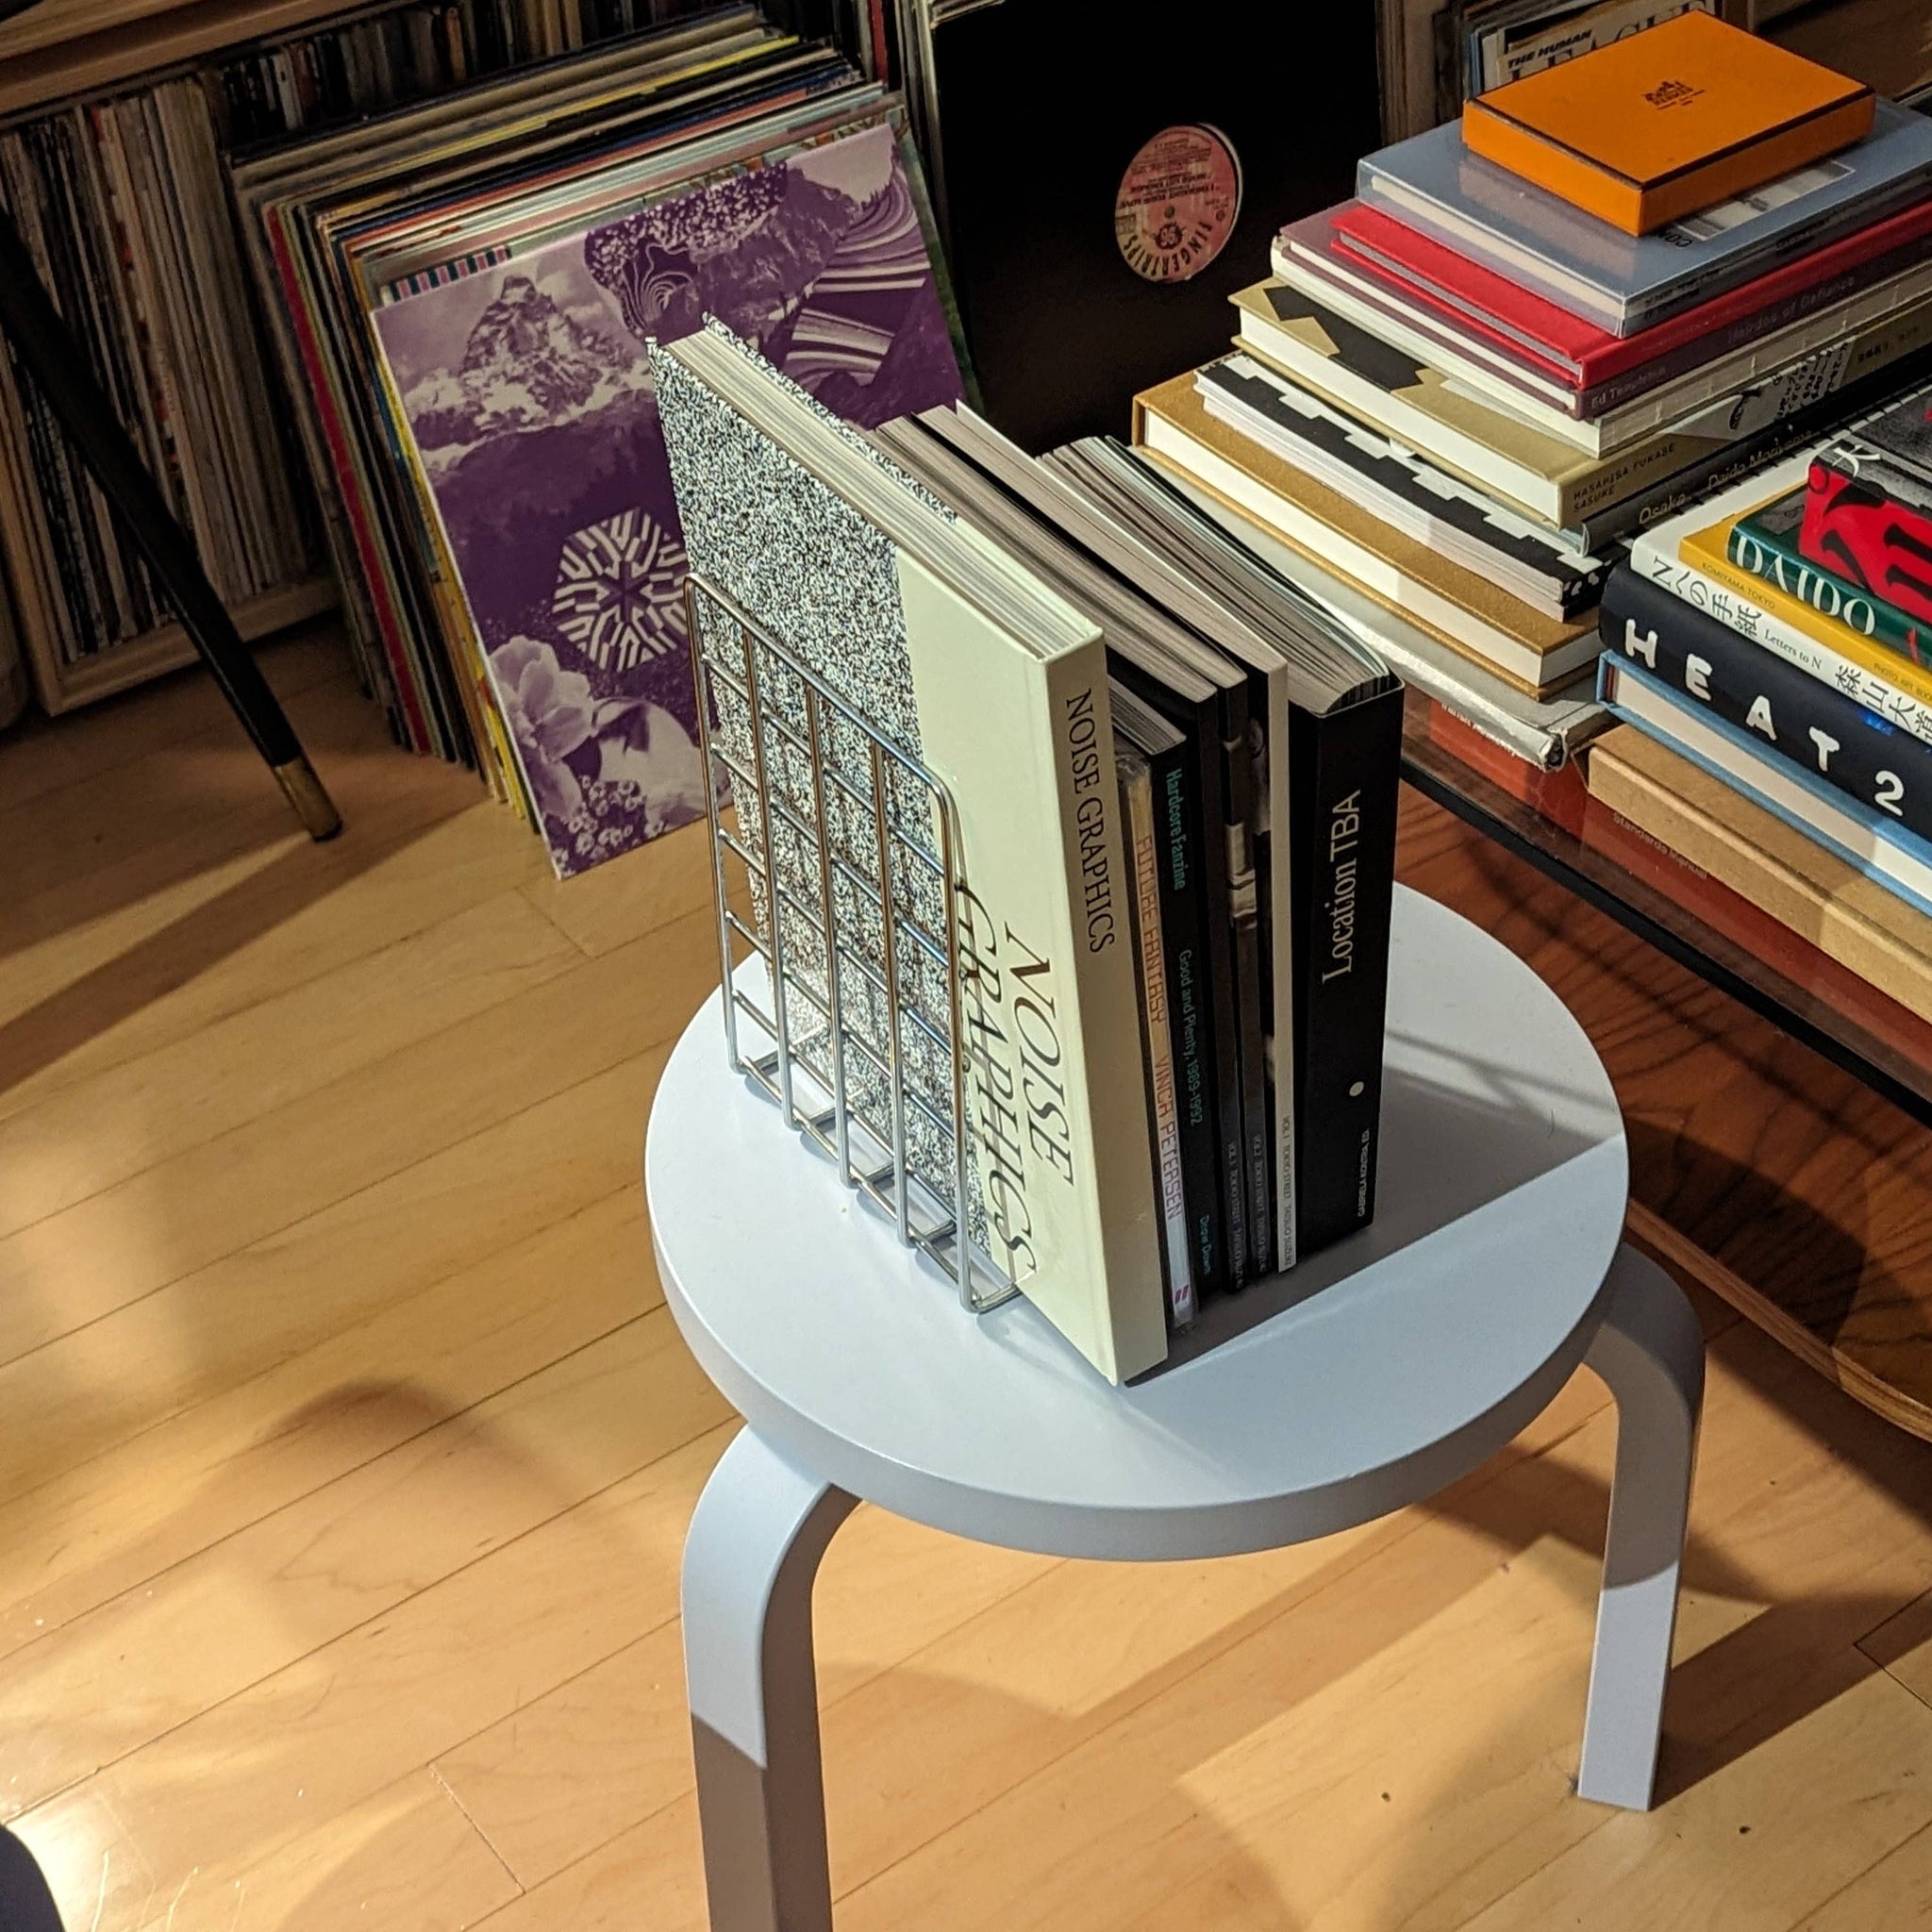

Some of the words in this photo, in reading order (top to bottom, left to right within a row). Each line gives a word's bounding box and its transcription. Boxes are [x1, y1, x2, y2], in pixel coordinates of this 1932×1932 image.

[1507, 52, 1535, 68] THE
[1538, 29, 1592, 57] HUMAN
[1574, 466, 1629, 500] MASAHISA
[1574, 485, 1616, 513] SASUKE
[1639, 491, 1687, 525] Osaka
[1707, 461, 1745, 491] Daido
[1652, 555, 1762, 638] Nへの手紙
[1701, 561, 1744, 594] KOMIYAMA
[1747, 591, 1775, 610] TOKYO
[1736, 535, 1875, 636] DAIDO
[1764, 628, 1797, 656] Letters
[1799, 650, 1809, 663] to
[1811, 658, 1823, 671] N
[1066, 688, 1101, 795] NOISE
[1624, 618, 1840, 772] HEAT
[1874, 770, 1905, 817] 2
[1165, 768, 1184, 836] Hardcore
[1329, 789, 1361, 863] TBA
[1076, 796, 1116, 954] GRAPHICS
[1136, 836, 1159, 924] FUTURE
[1171, 834, 1187, 891] Fanzine
[1322, 857, 1357, 985] Location
[1142, 926, 1166, 1024] FANTASY
[1179, 949, 1193, 988] Good
[1182, 989, 1194, 1015] and
[955, 882, 1038, 1273] GRAPHICS
[1005, 921, 1075, 1186] NOISE
[1154, 1055, 1173, 1119] VINCA
[1159, 1124, 1183, 1220] PETERSEN
